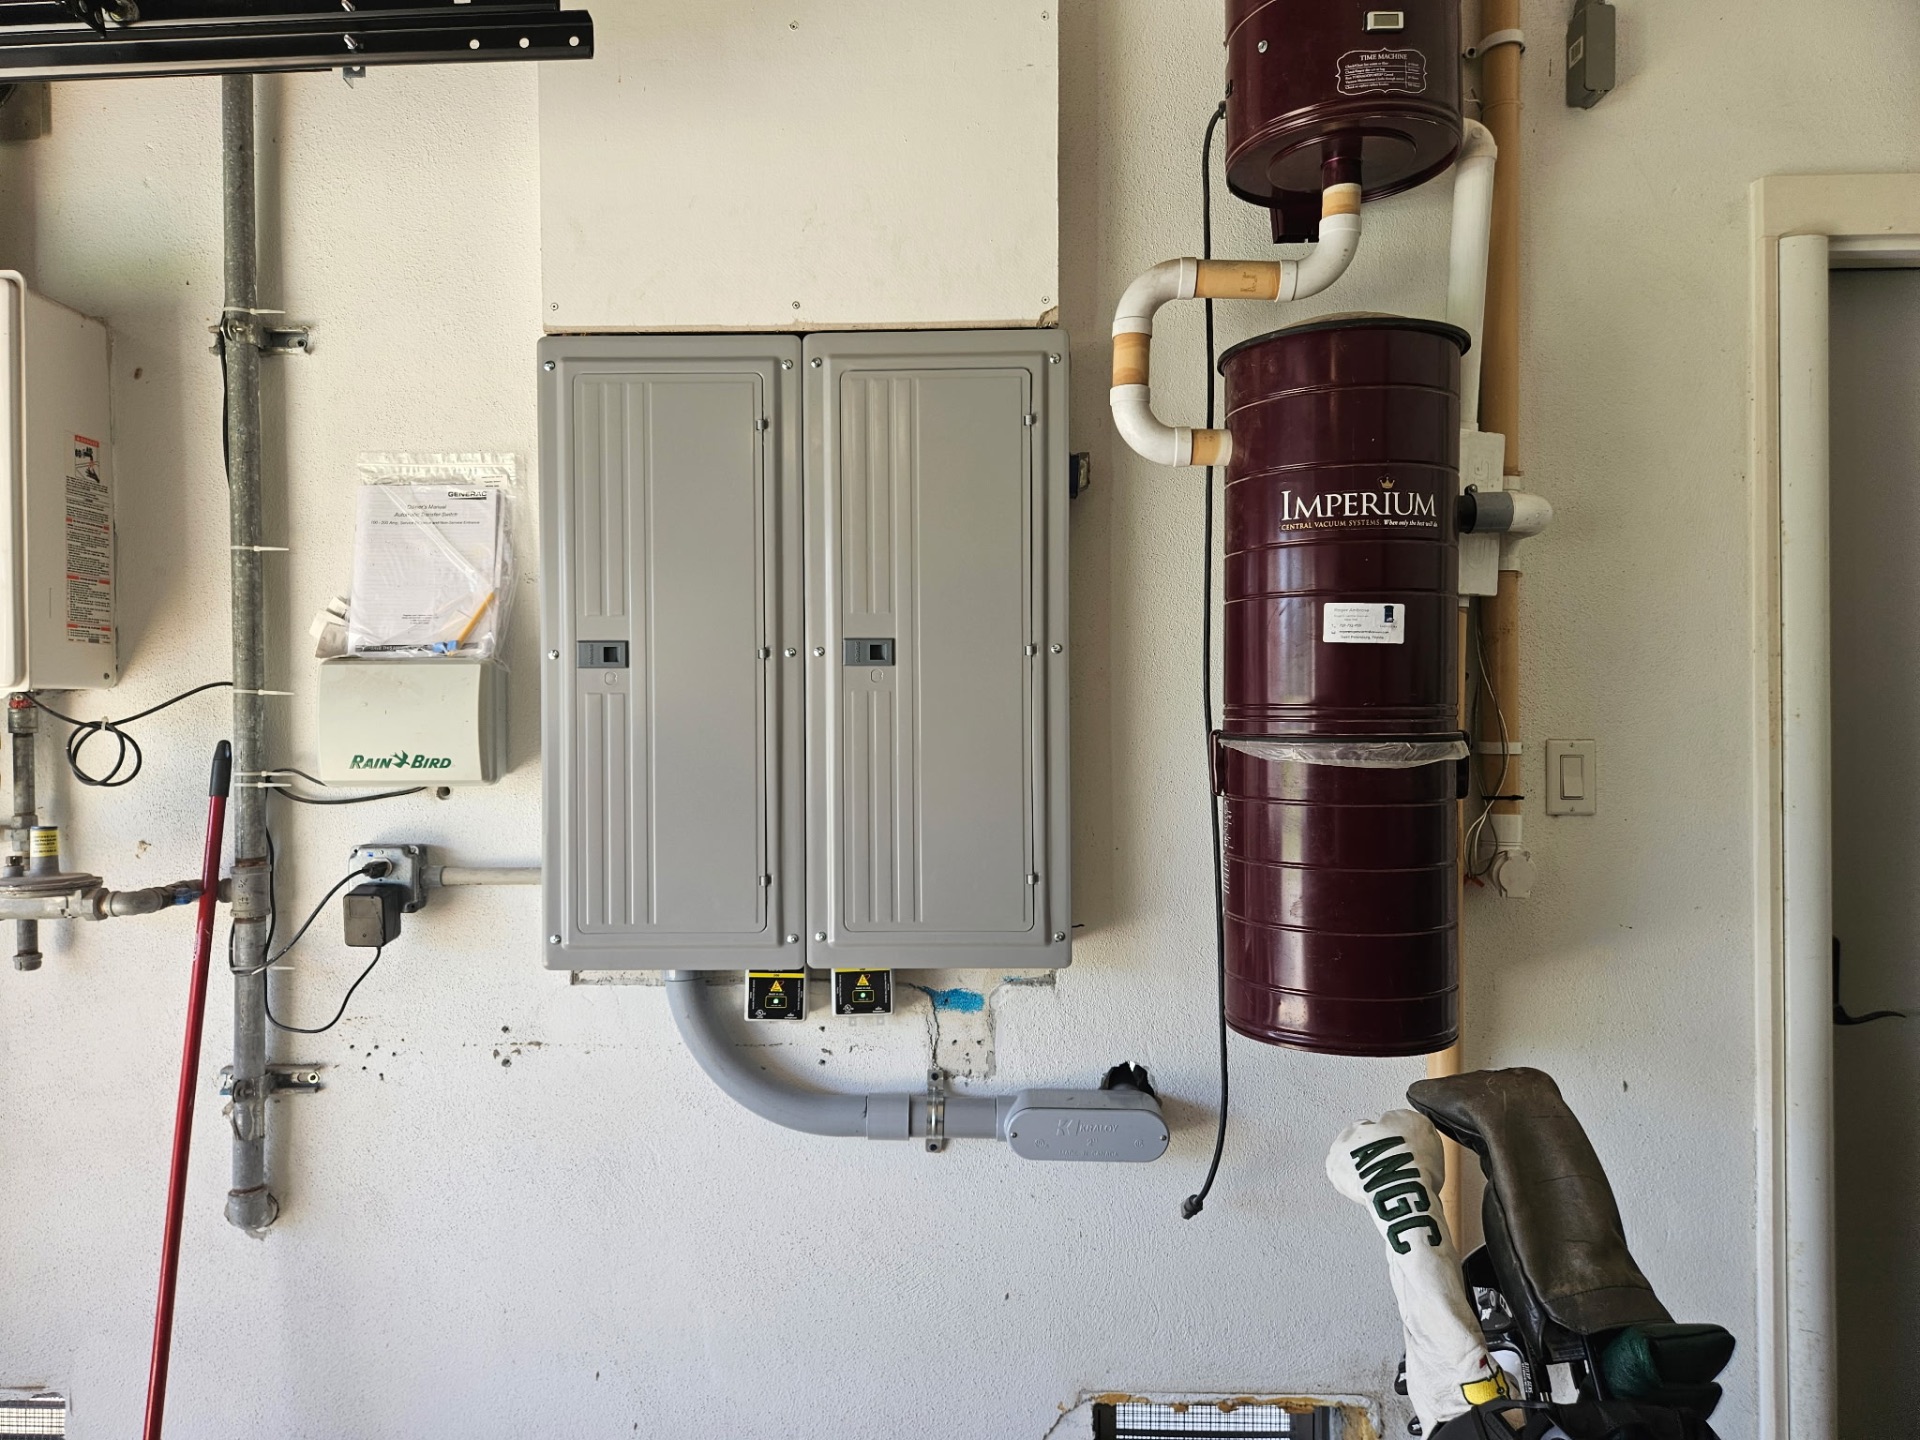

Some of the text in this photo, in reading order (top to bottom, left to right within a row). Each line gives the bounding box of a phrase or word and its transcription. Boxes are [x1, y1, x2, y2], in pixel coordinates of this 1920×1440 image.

[1281, 490, 1437, 521] IMPERIUM
[1281, 522, 1312, 531] CENTRAL
[1314, 520, 1347, 528] VACUUM
[1349, 519, 1382, 527] SYSTEMS.
[349, 754, 452, 769] RAIN BIRD
[1350, 1136, 1442, 1255] ANGC
